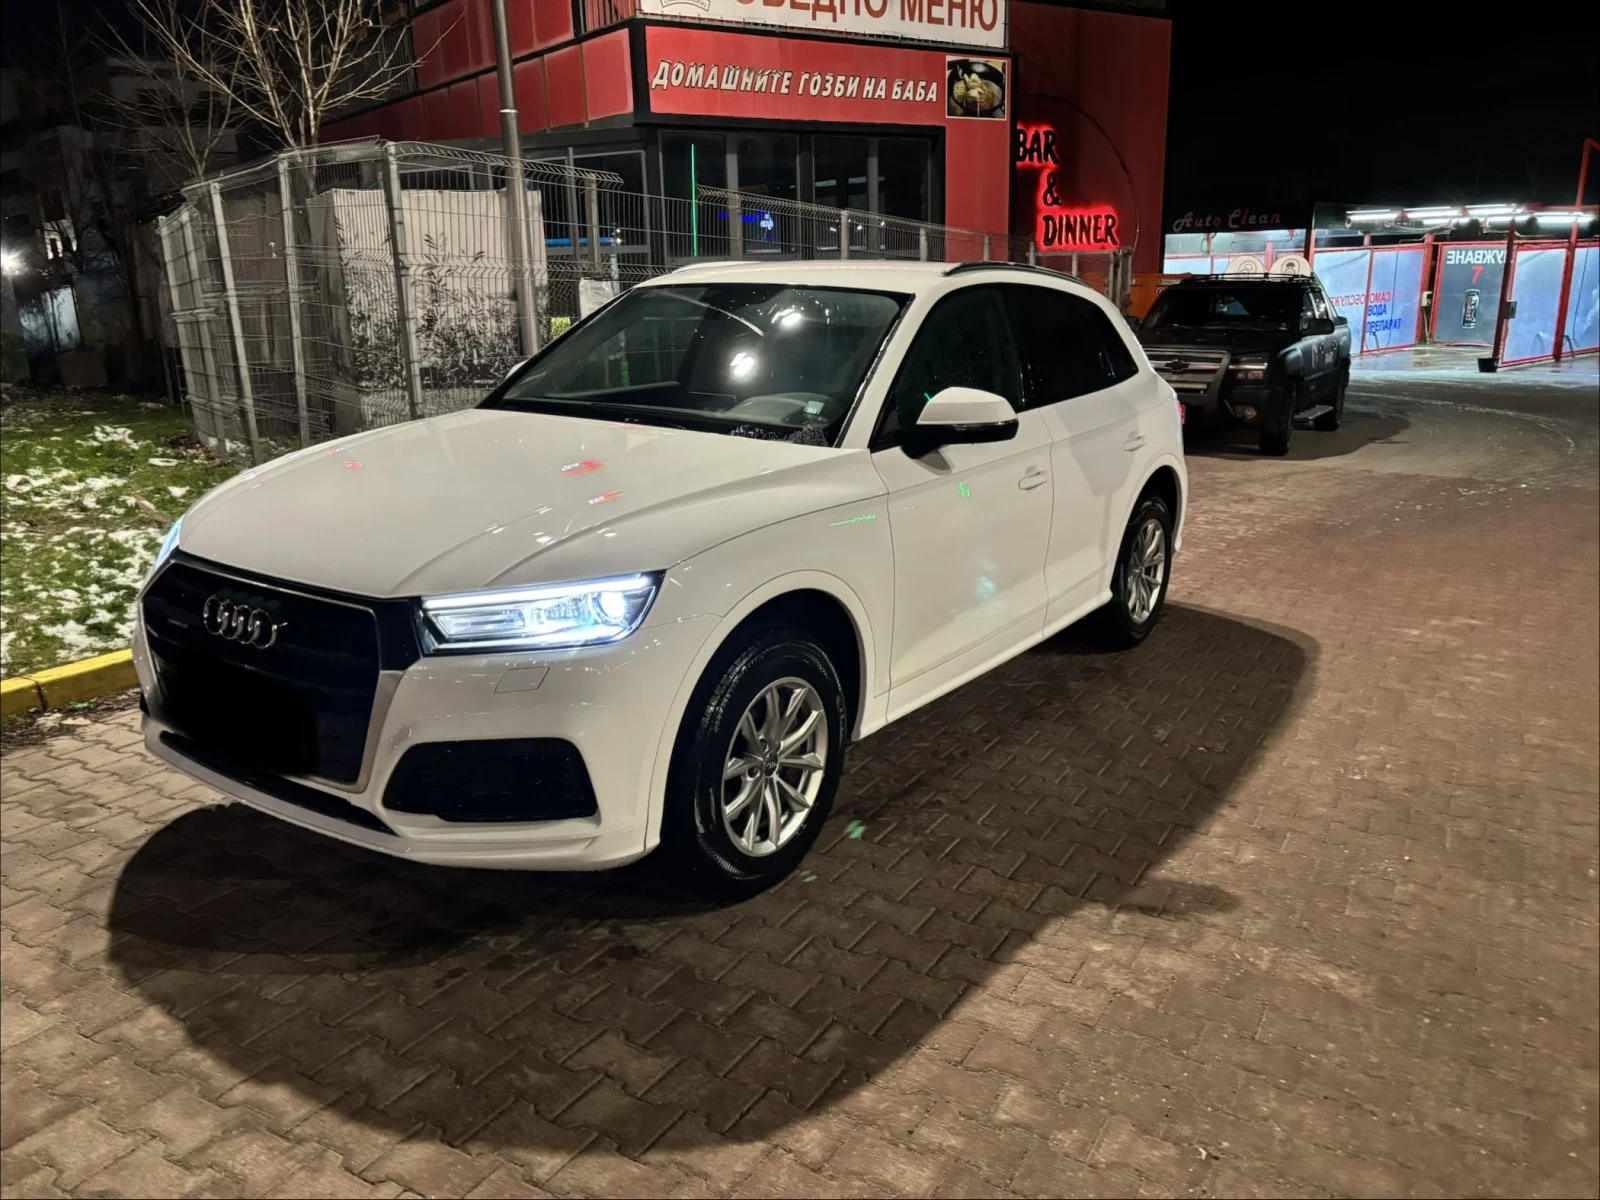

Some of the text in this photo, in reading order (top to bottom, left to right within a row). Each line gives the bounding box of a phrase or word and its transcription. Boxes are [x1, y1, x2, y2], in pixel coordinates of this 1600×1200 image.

[651, 59, 938, 102] ДОМАШНИТЕ ГОЗБИ НА БАБА
[1016, 128, 1060, 165] BAR
[1043, 172, 1062, 207] &
[1042, 213, 1119, 247] DINNER
[1172, 208, 1281, 232] Auto Clean
[1471, 265, 1484, 284] 7
[1367, 304, 1387, 317] ВОДА
[1367, 318, 1402, 333] ПРЕПАРАТ
